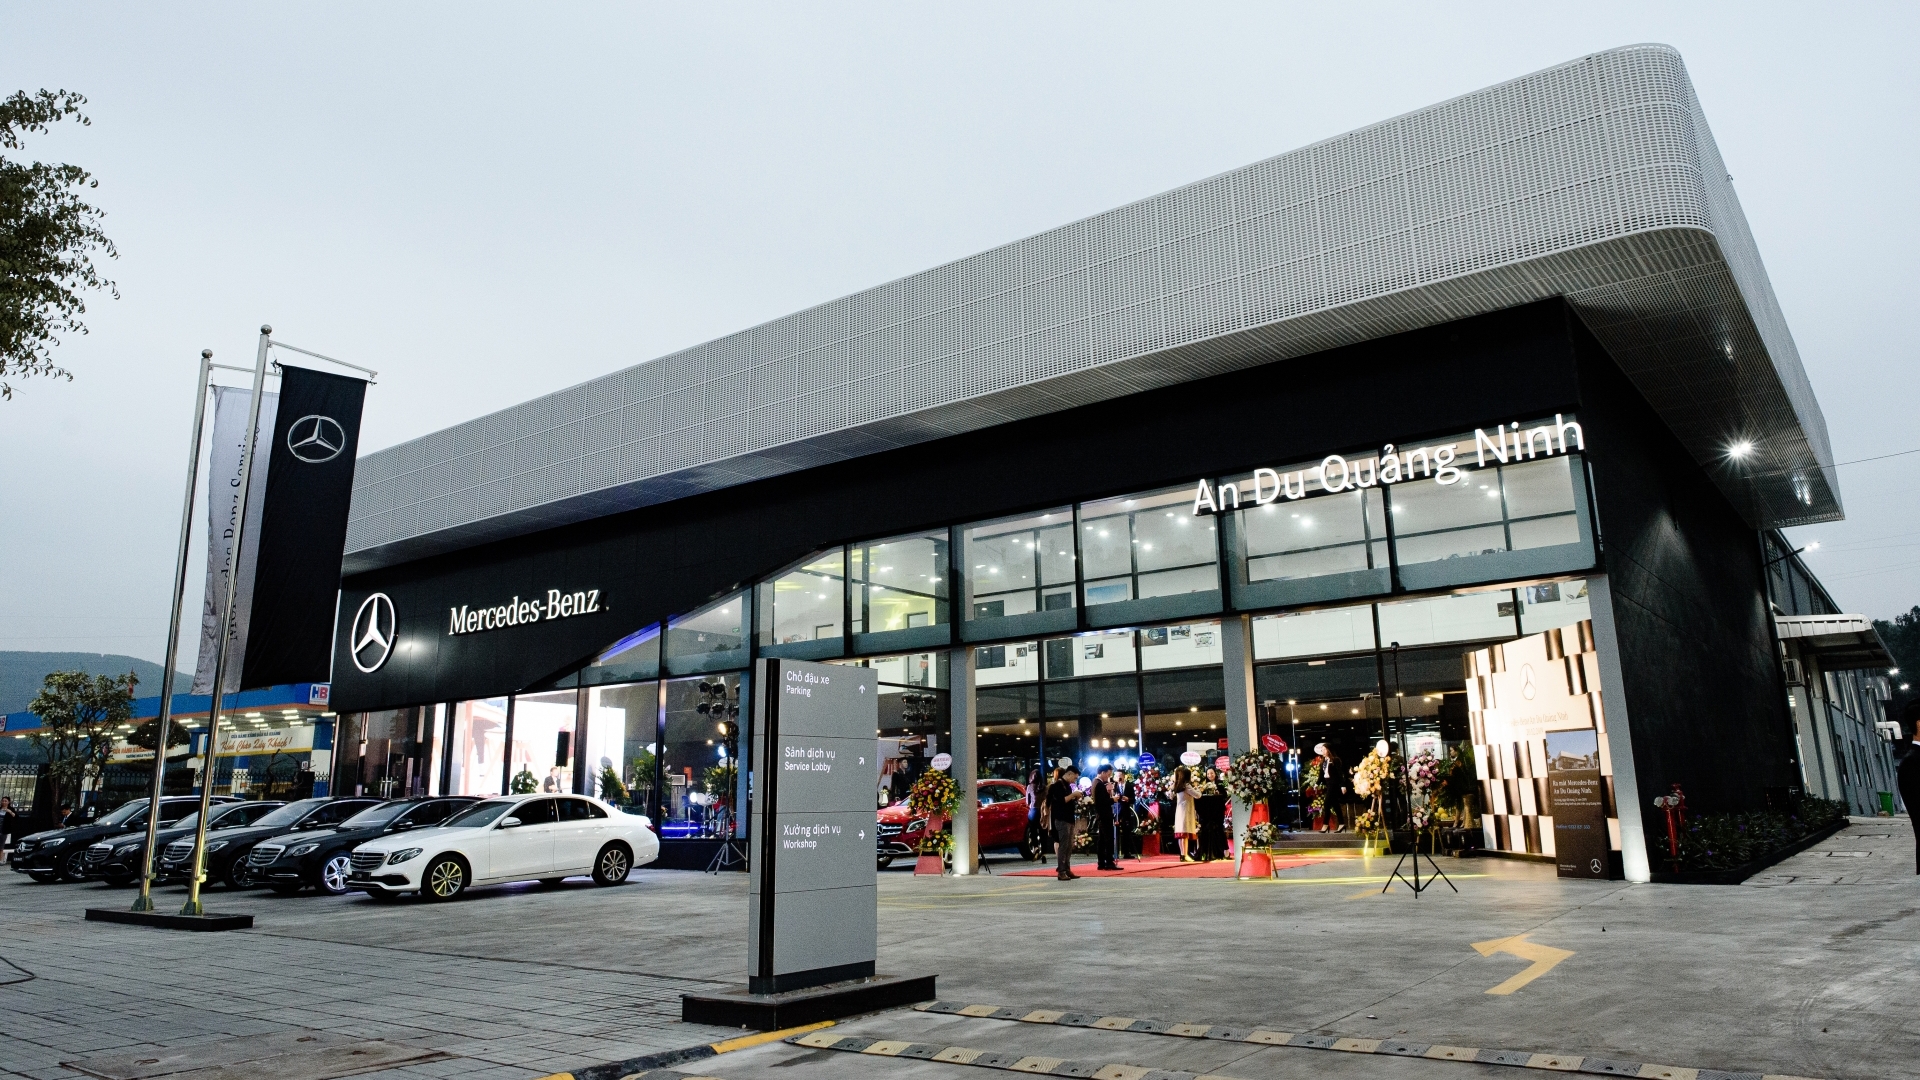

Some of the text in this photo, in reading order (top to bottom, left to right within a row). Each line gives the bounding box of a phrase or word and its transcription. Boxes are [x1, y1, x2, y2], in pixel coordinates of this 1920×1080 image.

[1192, 413, 1584, 516] An Du Quảng Ninh
[448, 588, 600, 636] Mercedes-Benz
[786, 670, 830, 685] Chỗ đậu xe
[311, 686, 328, 699] HB
[786, 685, 811, 697] Parking
[785, 746, 836, 761] Sảnh dịch vụ
[784, 761, 831, 773] Service Lobby
[783, 824, 841, 837] Xưởng dịch vụ
[783, 839, 817, 850] Workshop
